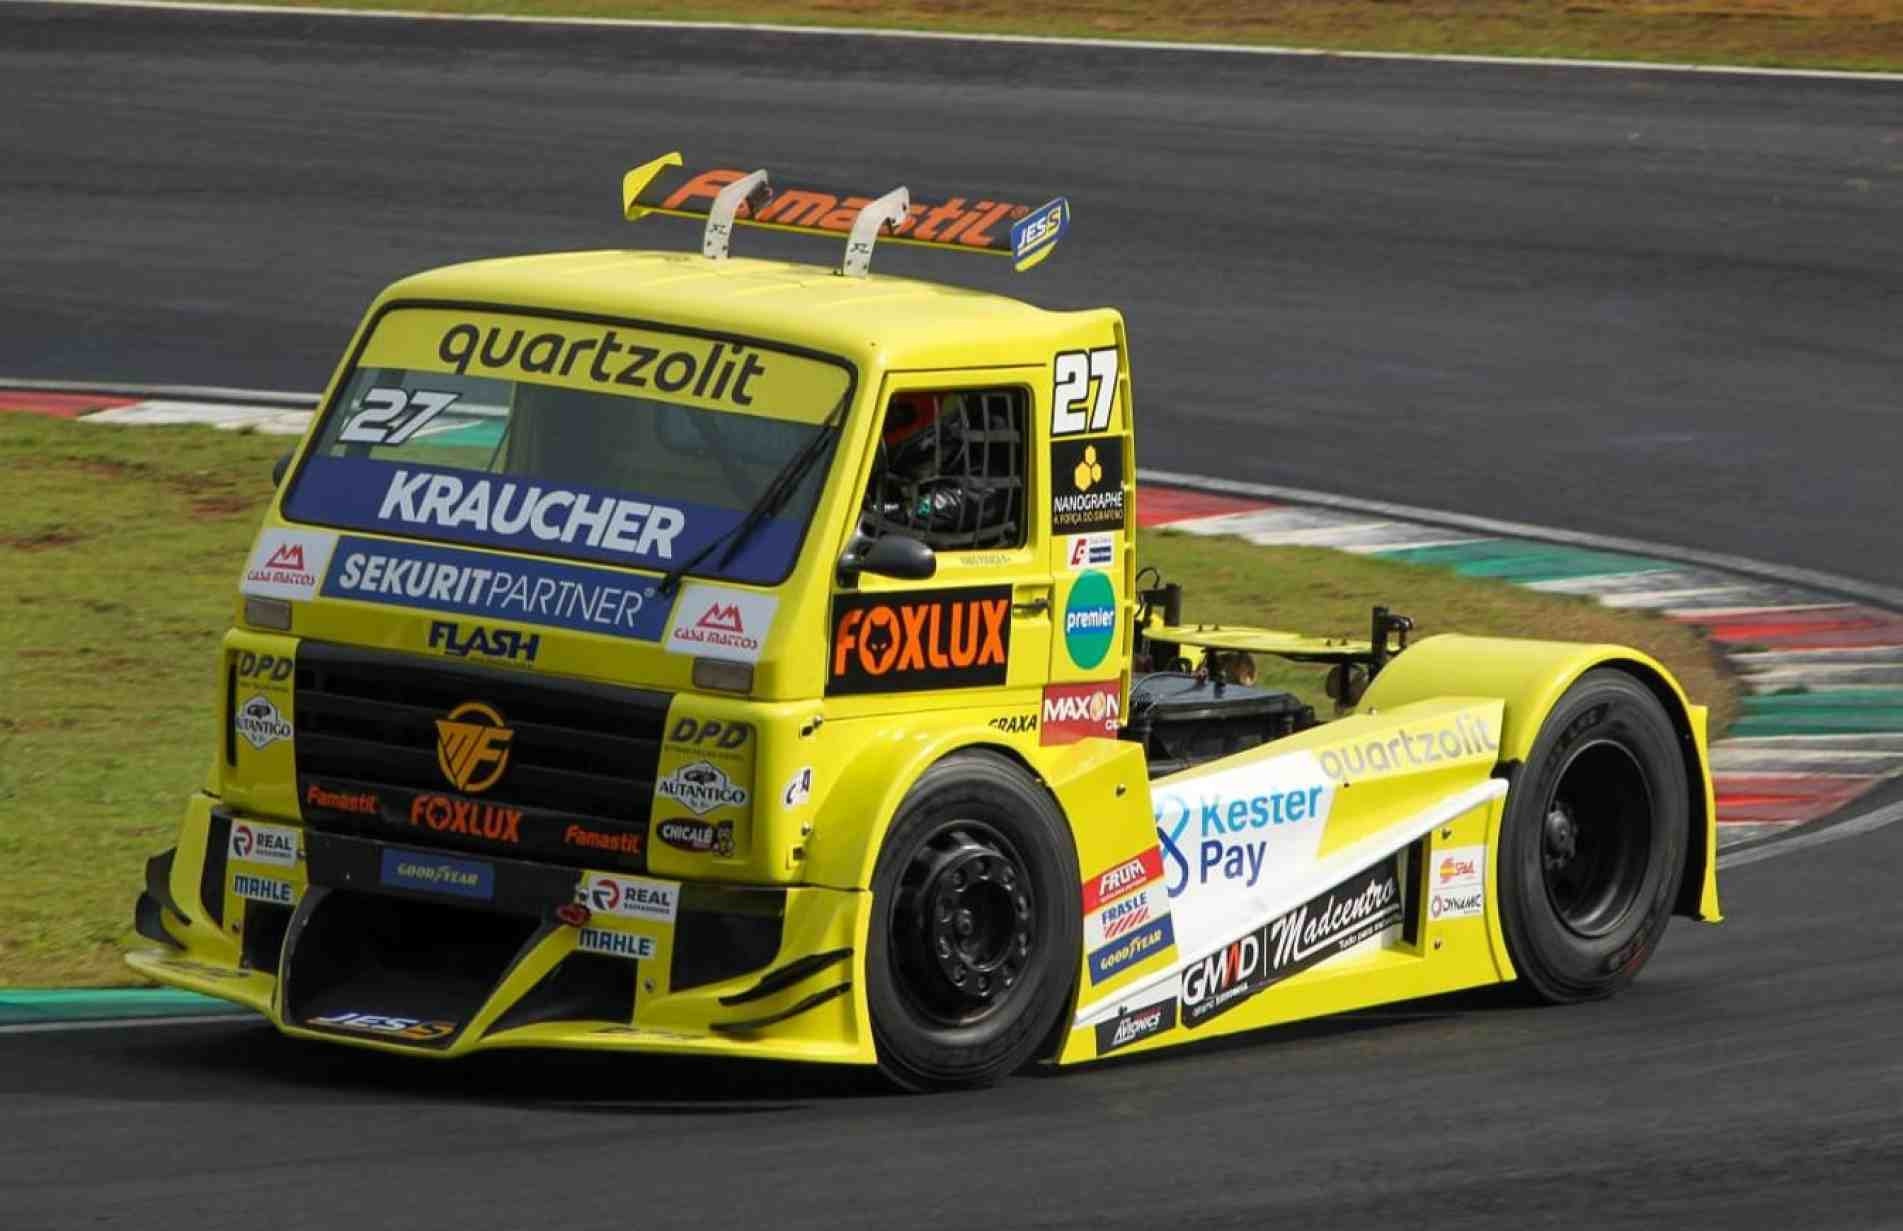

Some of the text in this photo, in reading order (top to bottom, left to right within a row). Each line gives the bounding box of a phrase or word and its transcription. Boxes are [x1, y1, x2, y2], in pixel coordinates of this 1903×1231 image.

[1018, 206, 1061, 247] JESS
[439, 323, 765, 404] quartzolit
[1051, 346, 1119, 435] 27
[340, 387, 458, 444] 27
[378, 470, 685, 560] KRAUCHER
[1054, 491, 1123, 513] NANOGRAPHE
[834, 600, 1008, 676] FOXLUX
[1066, 607, 1114, 633] premier
[428, 621, 540, 661] FLASH
[241, 651, 291, 680] DPD
[1044, 691, 1119, 721] MAXON
[671, 717, 749, 748] DPD
[1320, 715, 1497, 780] quartzolit
[660, 780, 745, 803] AUTANTIGO
[1201, 785, 1322, 836] Kester
[410, 793, 524, 843] FOXLUX
[256, 833, 292, 850] REAL
[565, 825, 640, 854] Famastil
[397, 864, 480, 885] GOODYEAR
[1201, 840, 1267, 887] Pay
[234, 875, 291, 901] MAHLE
[625, 887, 670, 907] REAL
[581, 928, 651, 956] MAHLE
[1270, 877, 1397, 970] Madcentro
[1100, 929, 1163, 970] GOODYEAR
